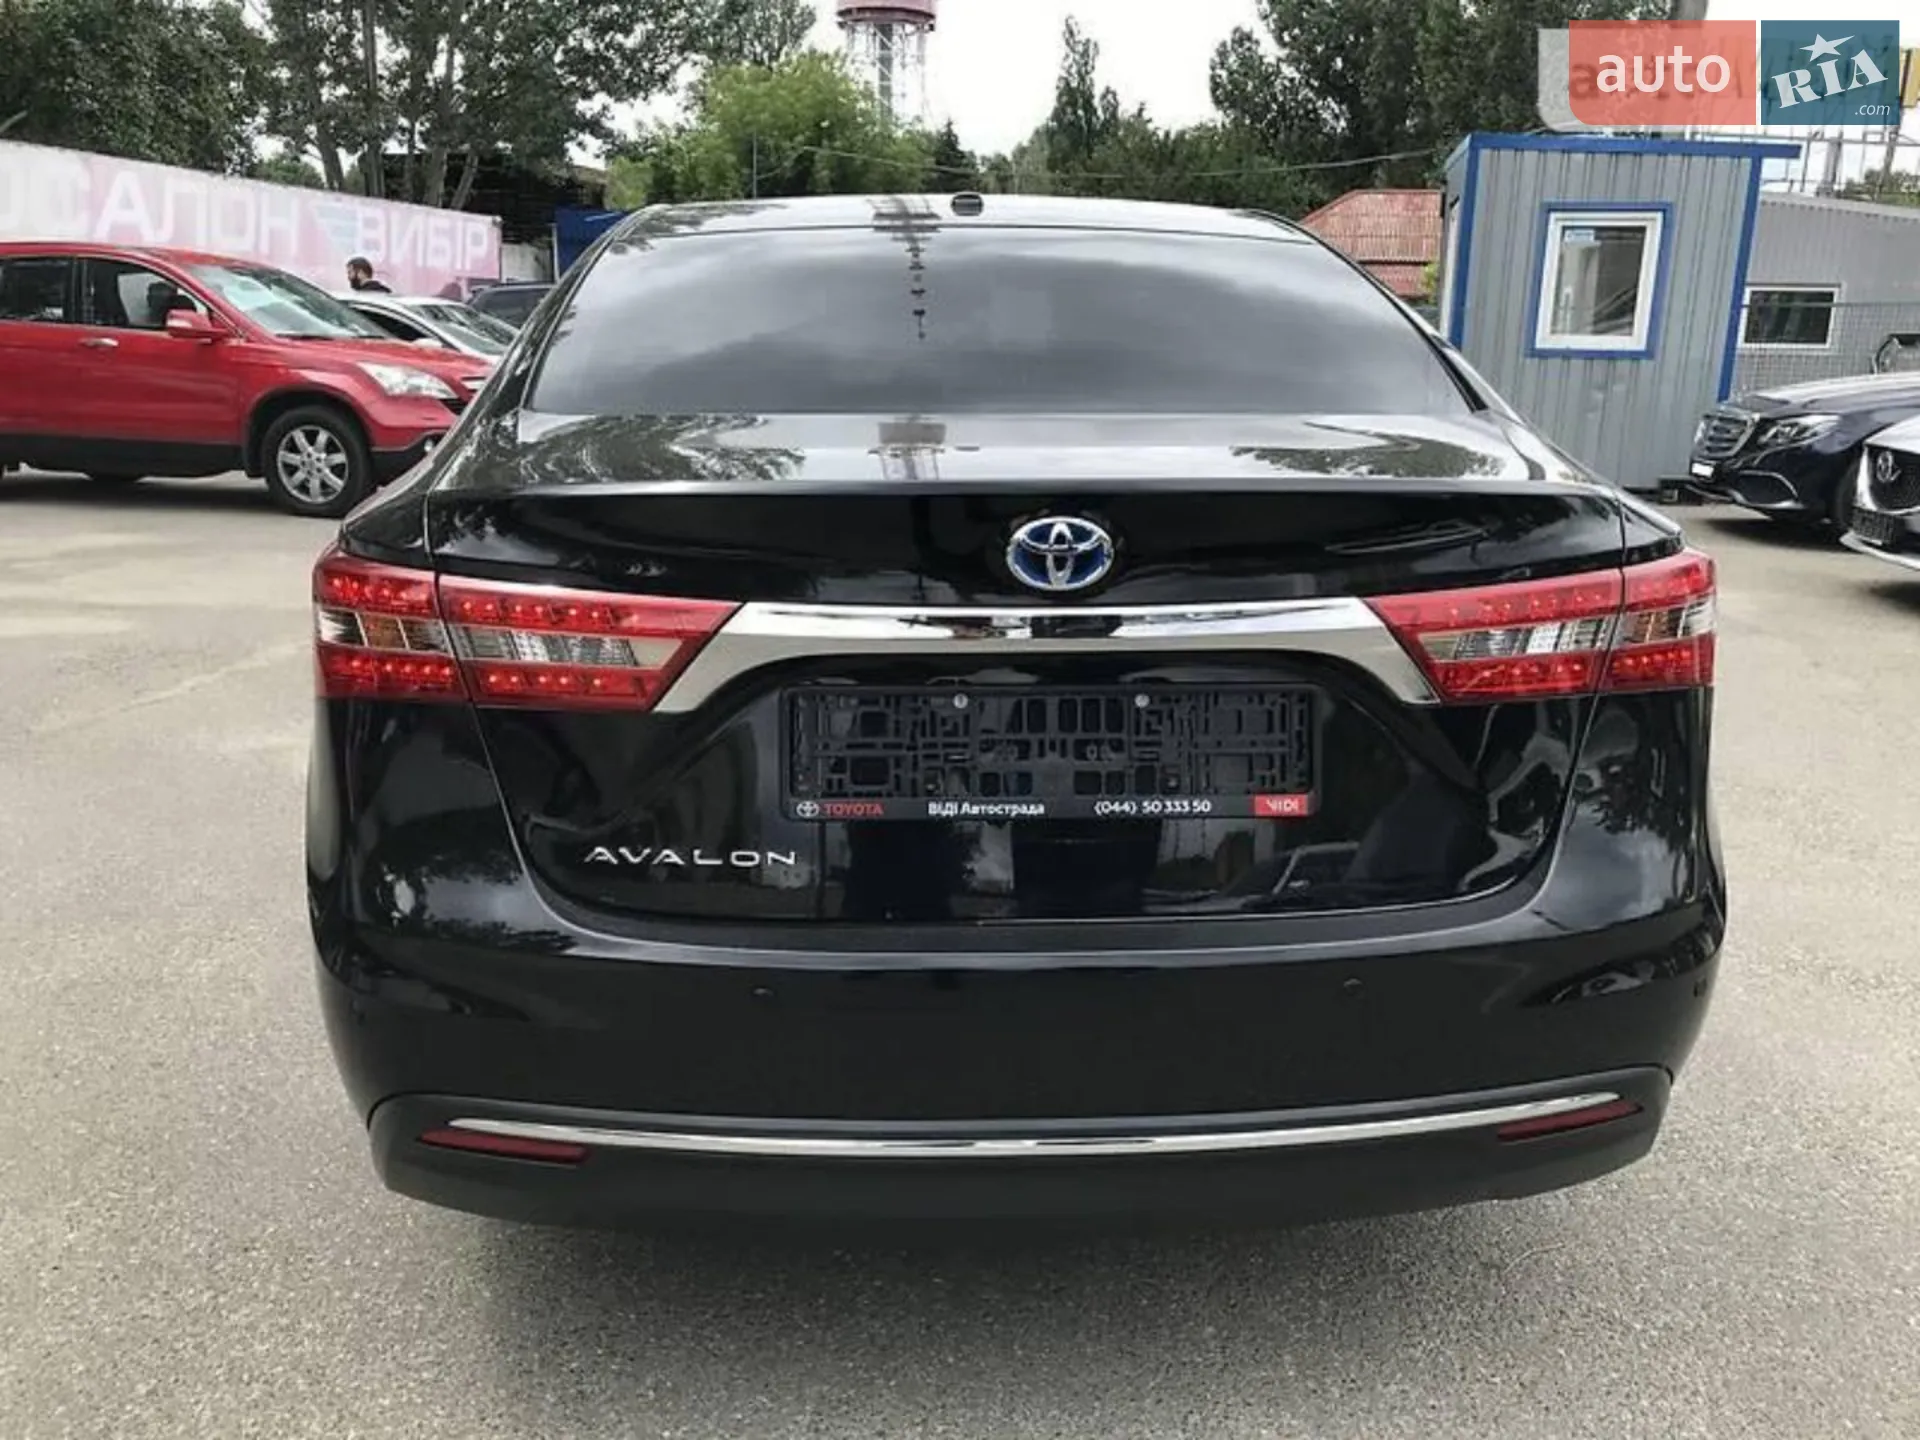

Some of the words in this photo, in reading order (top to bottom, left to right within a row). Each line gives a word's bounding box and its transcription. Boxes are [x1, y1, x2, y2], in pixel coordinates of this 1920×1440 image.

[356, 207, 489, 270] ВИБІР
[824, 803, 884, 815] TOYOTA
[960, 802, 1045, 817] Автострада
[1094, 800, 1137, 816] (044)
[584, 846, 796, 867] AVALON
